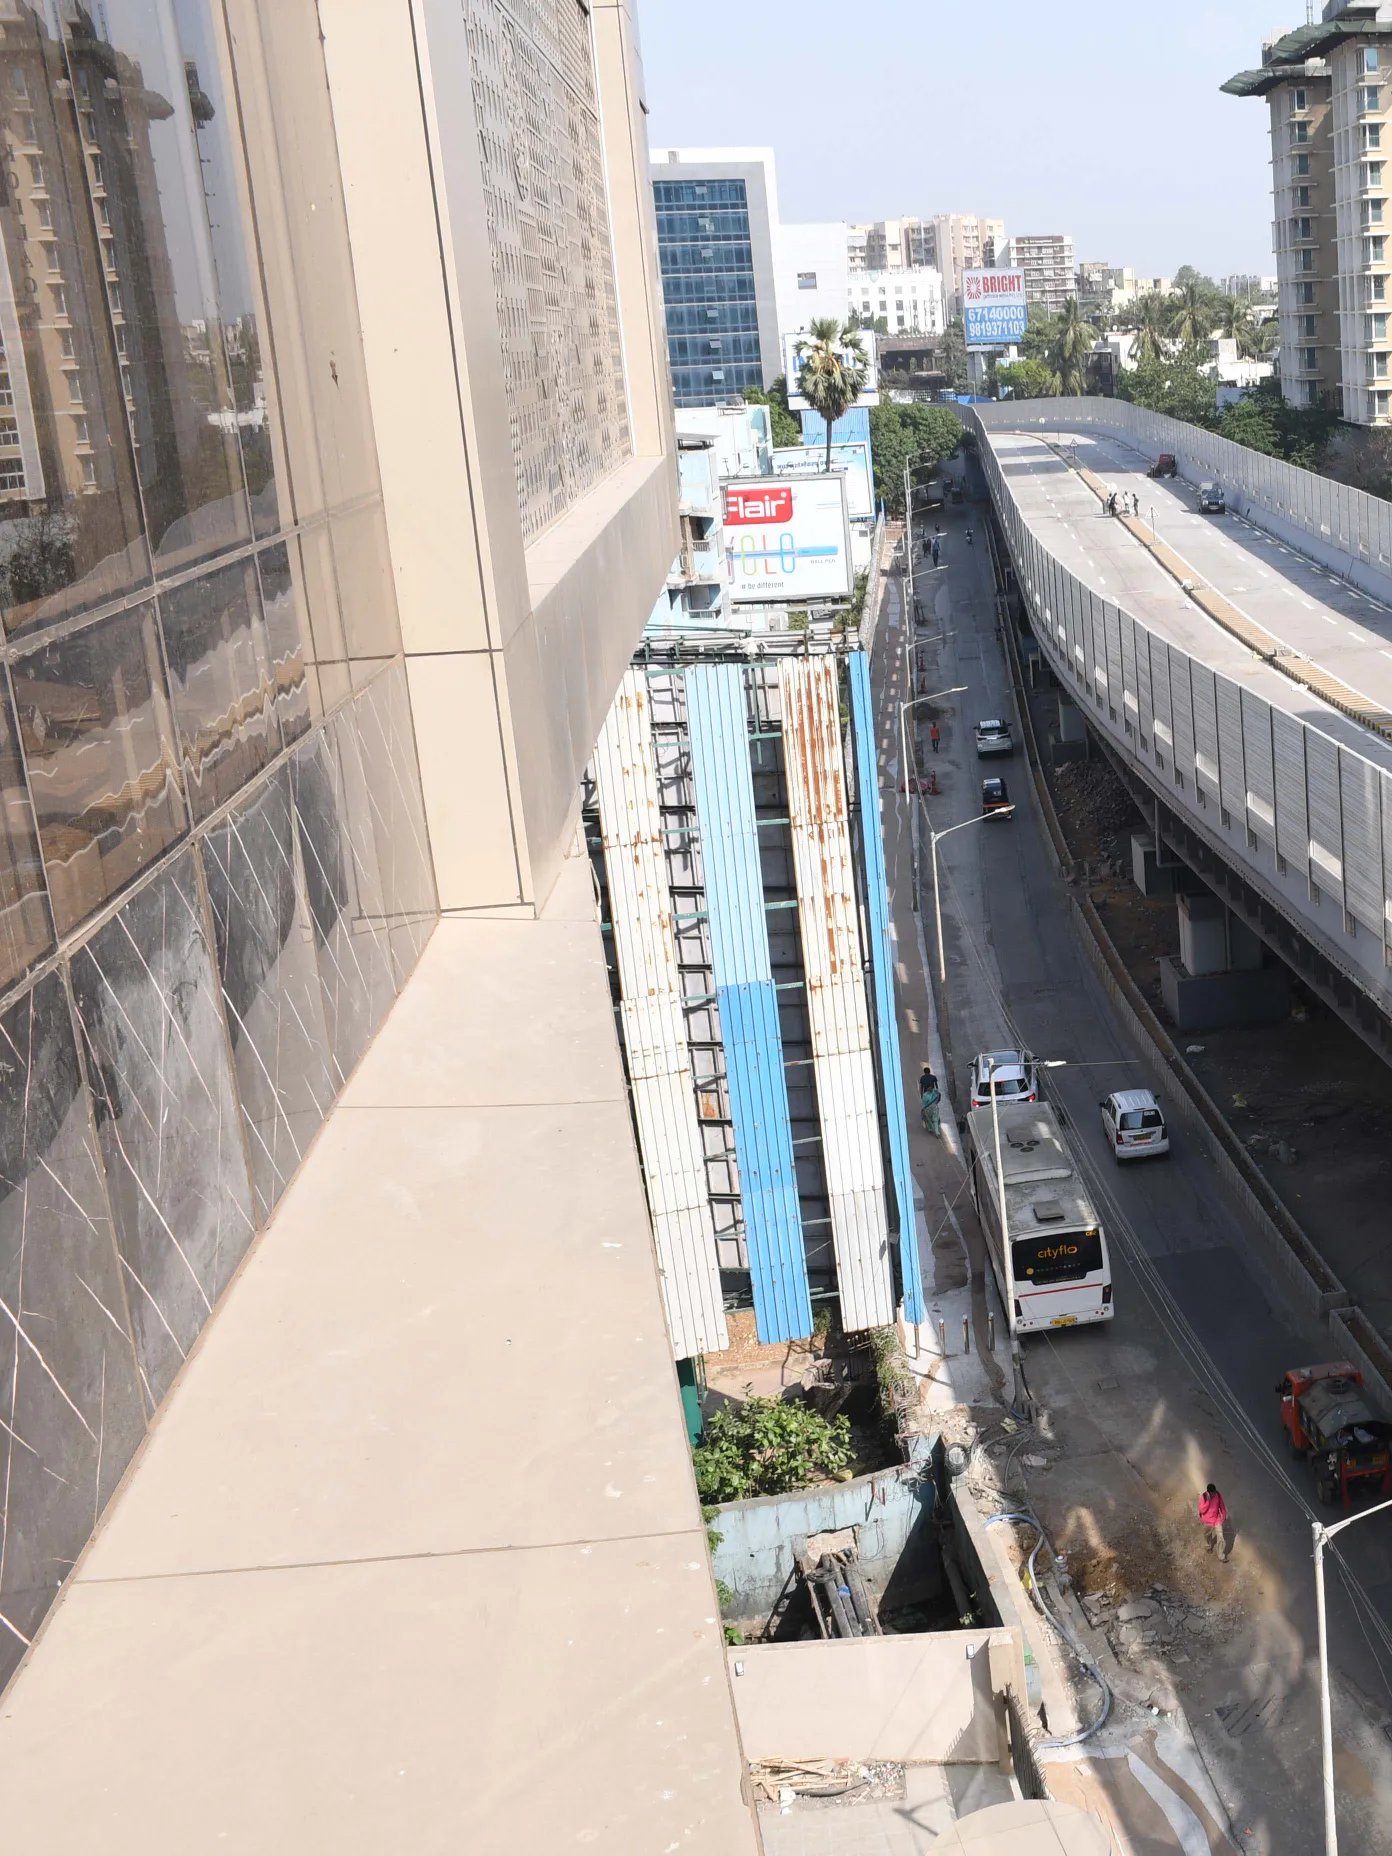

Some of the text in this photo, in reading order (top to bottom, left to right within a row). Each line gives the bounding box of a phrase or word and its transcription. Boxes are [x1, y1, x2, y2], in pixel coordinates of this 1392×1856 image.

[982, 275, 1022, 293] BRIGHT
[968, 306, 1024, 321] 67140000
[969, 321, 1025, 336] 9819371103
[727, 495, 785, 518] Flair
[747, 582, 756, 590] be
[757, 581, 784, 589] different
[1037, 1245, 1078, 1259] cityflo
